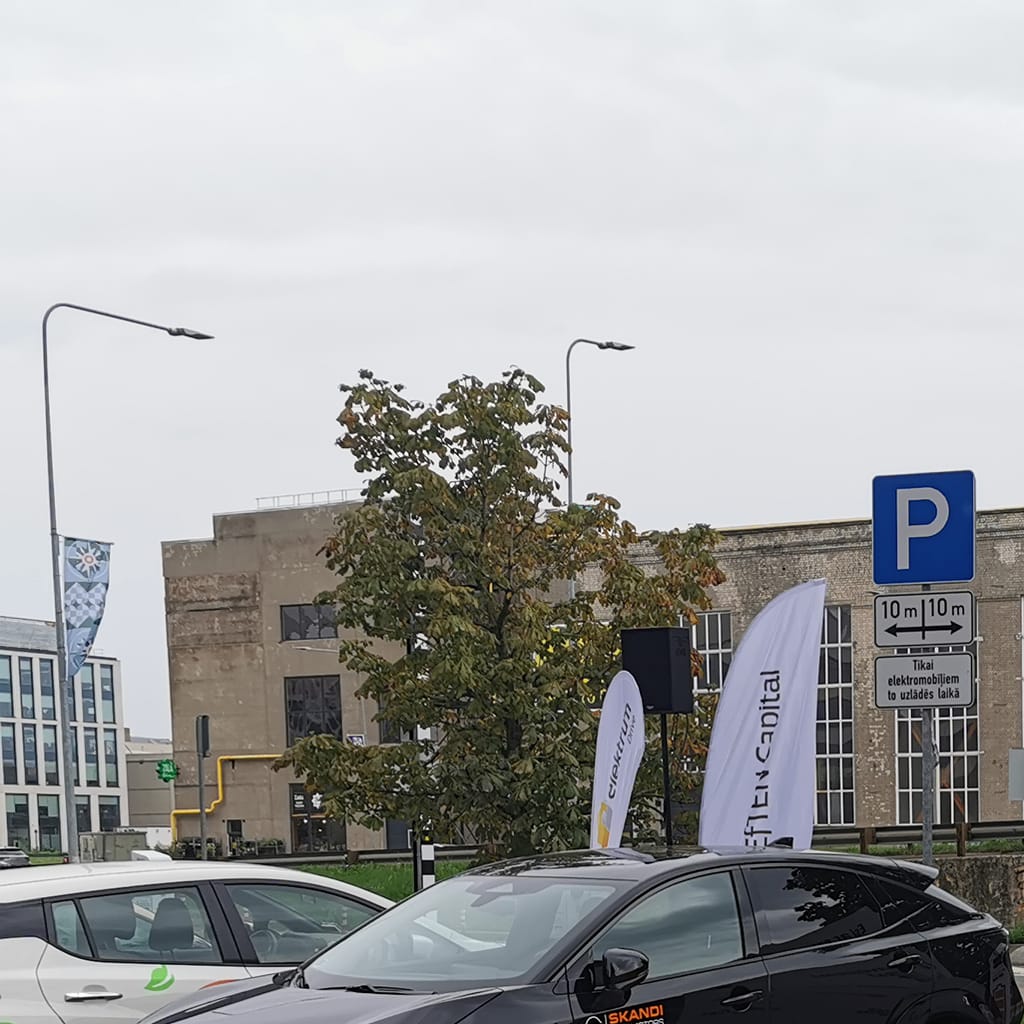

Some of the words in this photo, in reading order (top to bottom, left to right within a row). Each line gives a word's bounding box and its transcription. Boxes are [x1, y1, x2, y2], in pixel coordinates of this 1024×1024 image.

[896, 486, 950, 570] P
[881, 600, 901, 619] 10
[904, 605, 918, 618] m
[928, 598, 948, 617] 10
[951, 603, 966, 616] m
[912, 659, 934, 671] Tikai
[888, 689, 897, 700] to
[900, 688, 934, 701] uzlādēs
[938, 685, 960, 699] laikā
[756, 669, 780, 764] Capital
[608, 1004, 664, 1024] SKANDI
